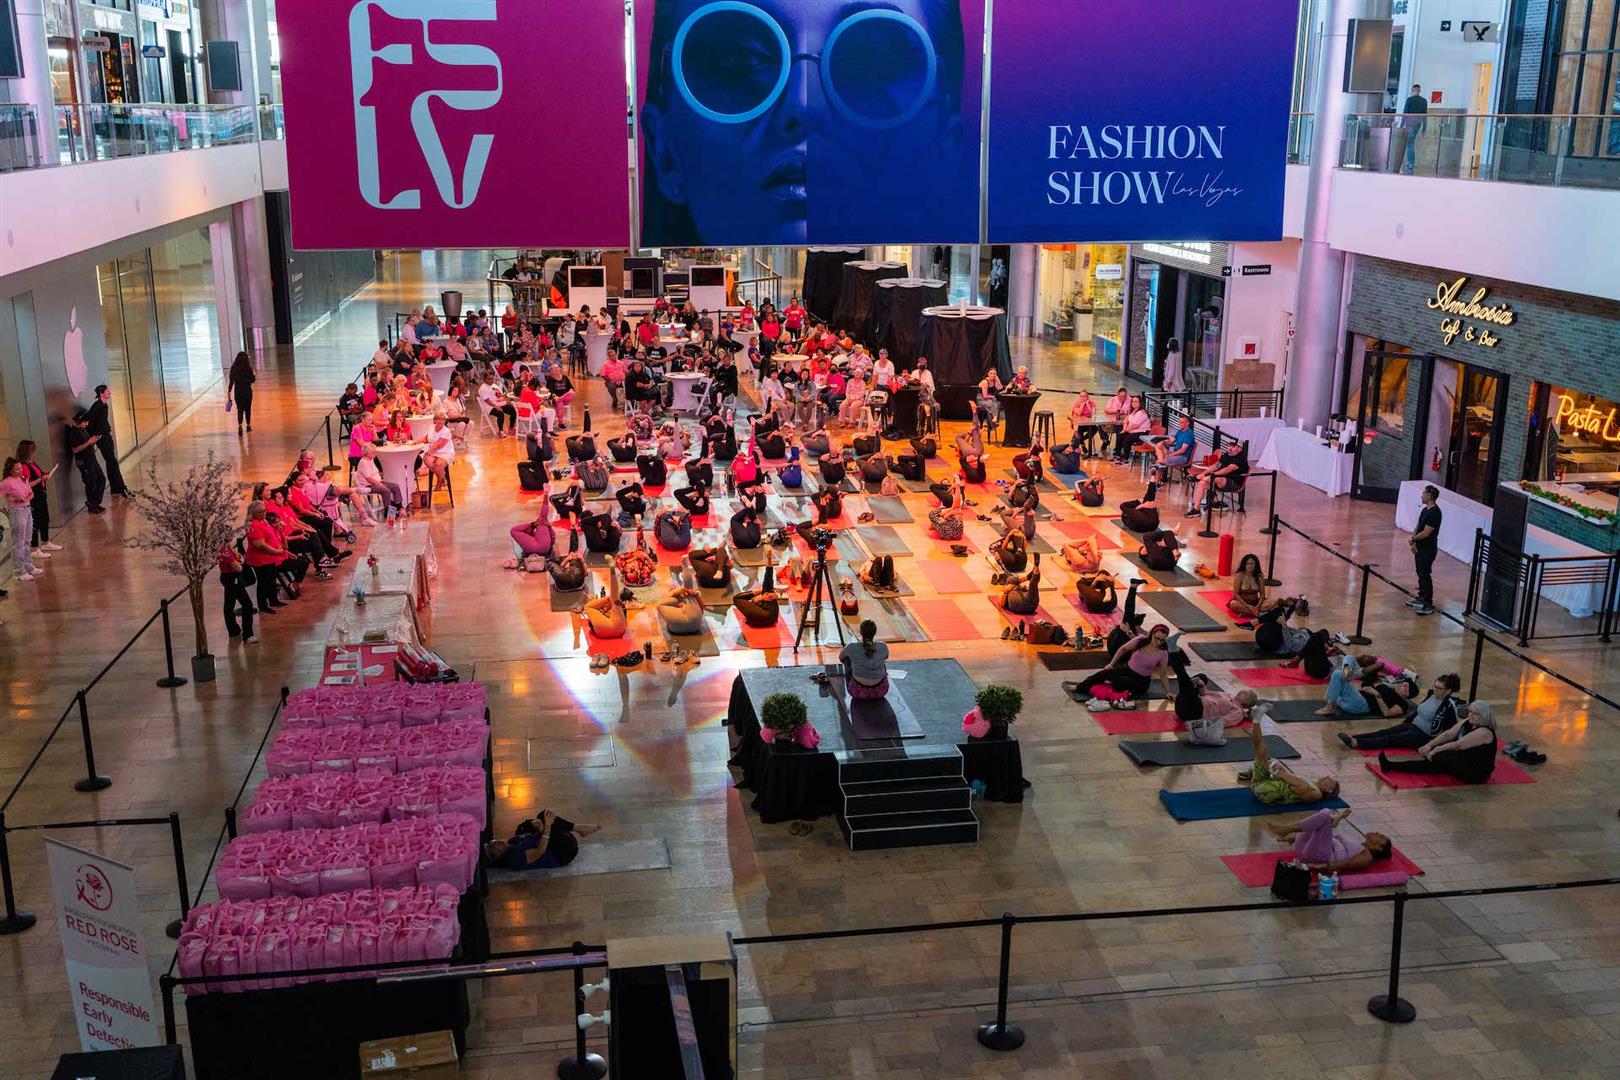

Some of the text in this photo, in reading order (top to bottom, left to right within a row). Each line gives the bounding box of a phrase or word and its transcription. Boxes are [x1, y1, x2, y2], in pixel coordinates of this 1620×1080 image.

[1047, 125, 1226, 159] FASHION
[1047, 170, 1244, 207] SHOW Las Vegas
[1427, 277, 1513, 326] Ambrosia
[1465, 327, 1475, 341] &
[1478, 330, 1499, 347] Bar
[1556, 395, 1602, 434] Pasta
[65, 914, 97, 936] RED
[100, 927, 139, 954] ROSE
[79, 981, 151, 1022] Responsible
[83, 1002, 113, 1027] Early
